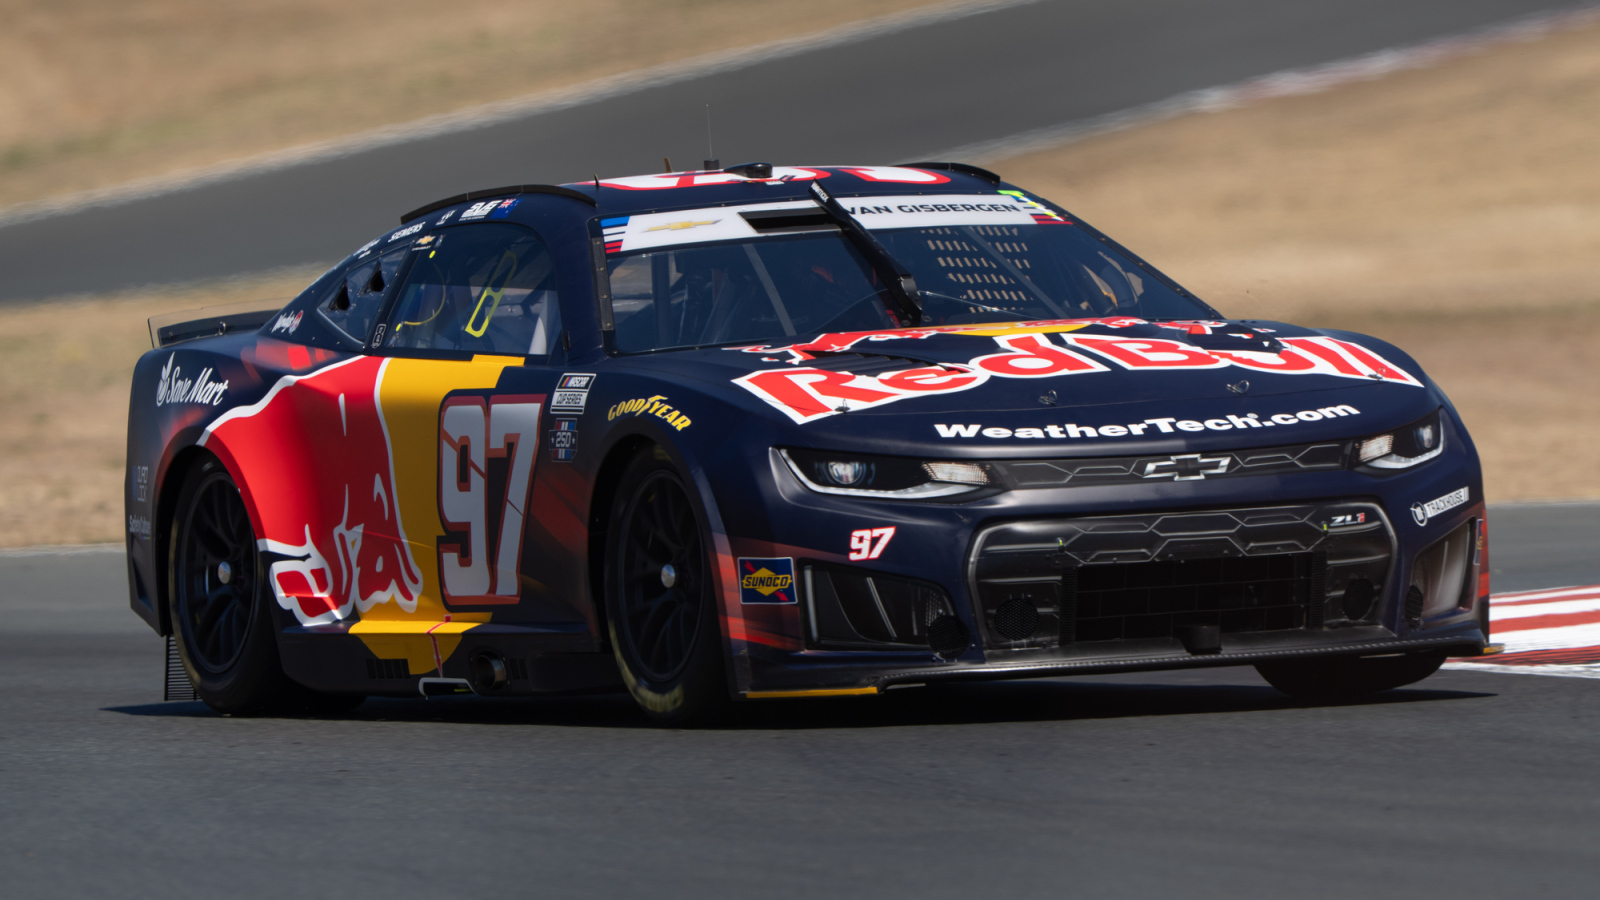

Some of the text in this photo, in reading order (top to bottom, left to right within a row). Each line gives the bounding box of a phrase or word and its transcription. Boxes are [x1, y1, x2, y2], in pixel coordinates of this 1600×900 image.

[897, 204, 1021, 213] GISBERGEN
[388, 221, 426, 242] SIEMENS
[166, 366, 229, 406] Save Mart
[731, 333, 1110, 425] Red
[556, 393, 583, 405] CUP SERIES
[608, 395, 692, 431] GOODYEAR
[555, 432, 572, 448] 250
[439, 394, 547, 606] 97
[1427, 490, 1464, 516] TRACKHOUSE
[1330, 512, 1366, 527] ZL1
[849, 526, 896, 561] 97
[745, 576, 790, 588] SUNOCO
